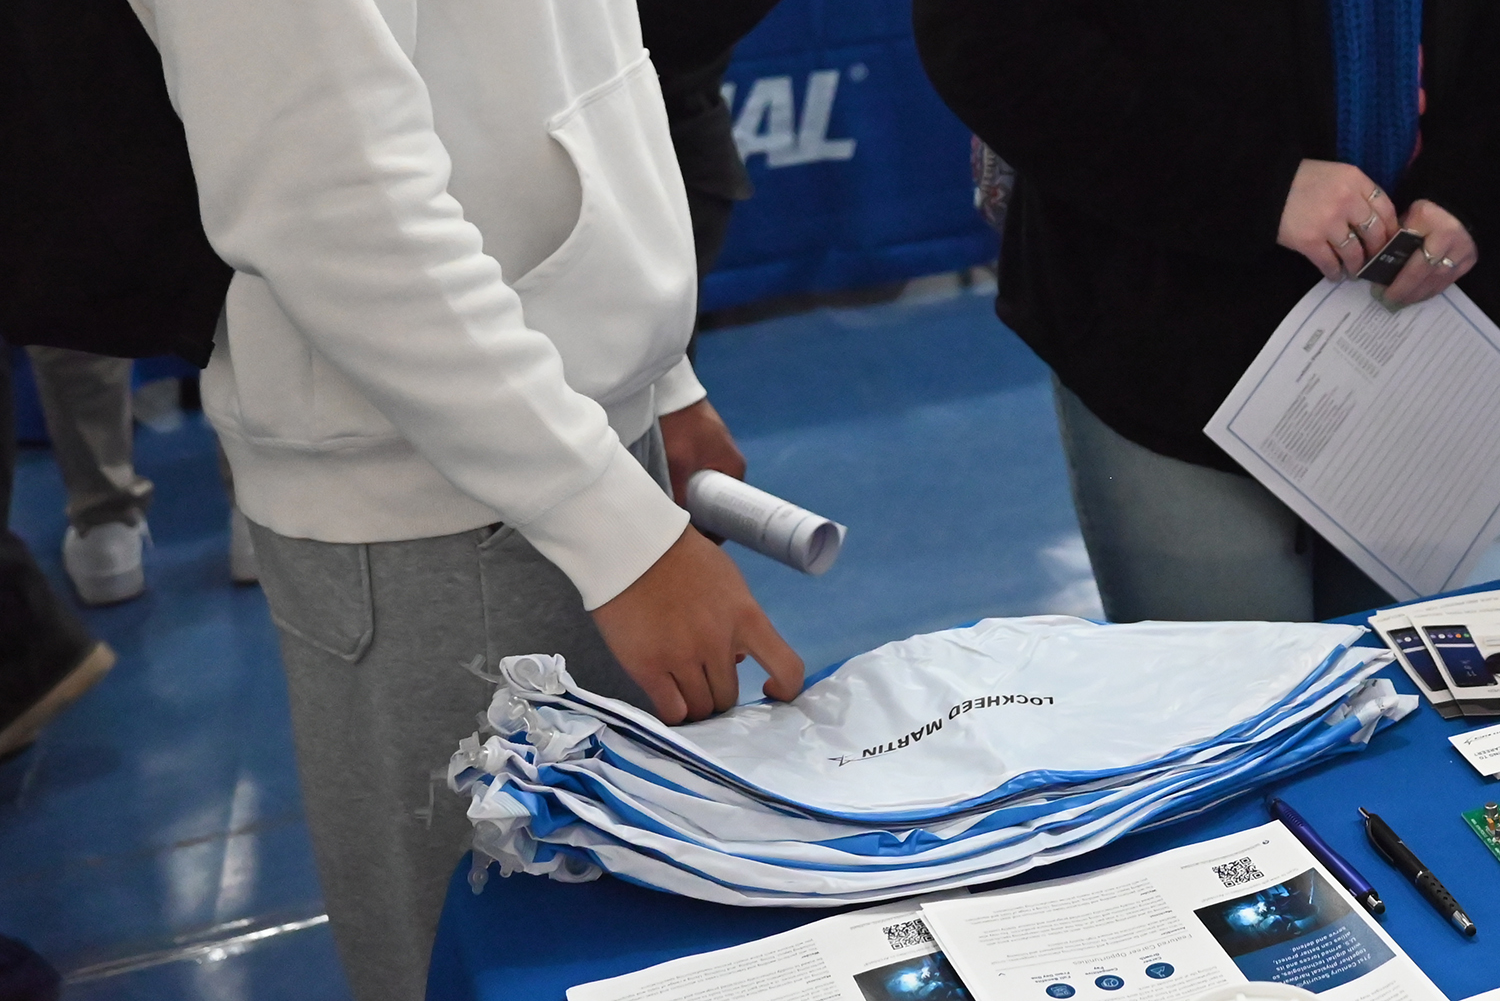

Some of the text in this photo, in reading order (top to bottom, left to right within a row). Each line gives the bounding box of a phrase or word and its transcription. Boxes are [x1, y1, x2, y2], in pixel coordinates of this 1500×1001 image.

[720, 69, 857, 169] AL
[861, 695, 1053, 757] LOCKHEED MARTIN
[1288, 925, 1347, 952] serve and defend.
[1345, 942, 1362, 952] with
[1071, 933, 1193, 966] Featured Career Opportunities
[1271, 931, 1353, 965] allies can better protect,
[1319, 944, 1344, 957] armed
[1324, 949, 1348, 962] digital
[1279, 947, 1368, 984] together physical hardwar
[1284, 961, 1300, 969] and
[1298, 953, 1322, 964] forces
[1328, 960, 1358, 975] Century
[1280, 959, 1327, 977] technologies,
